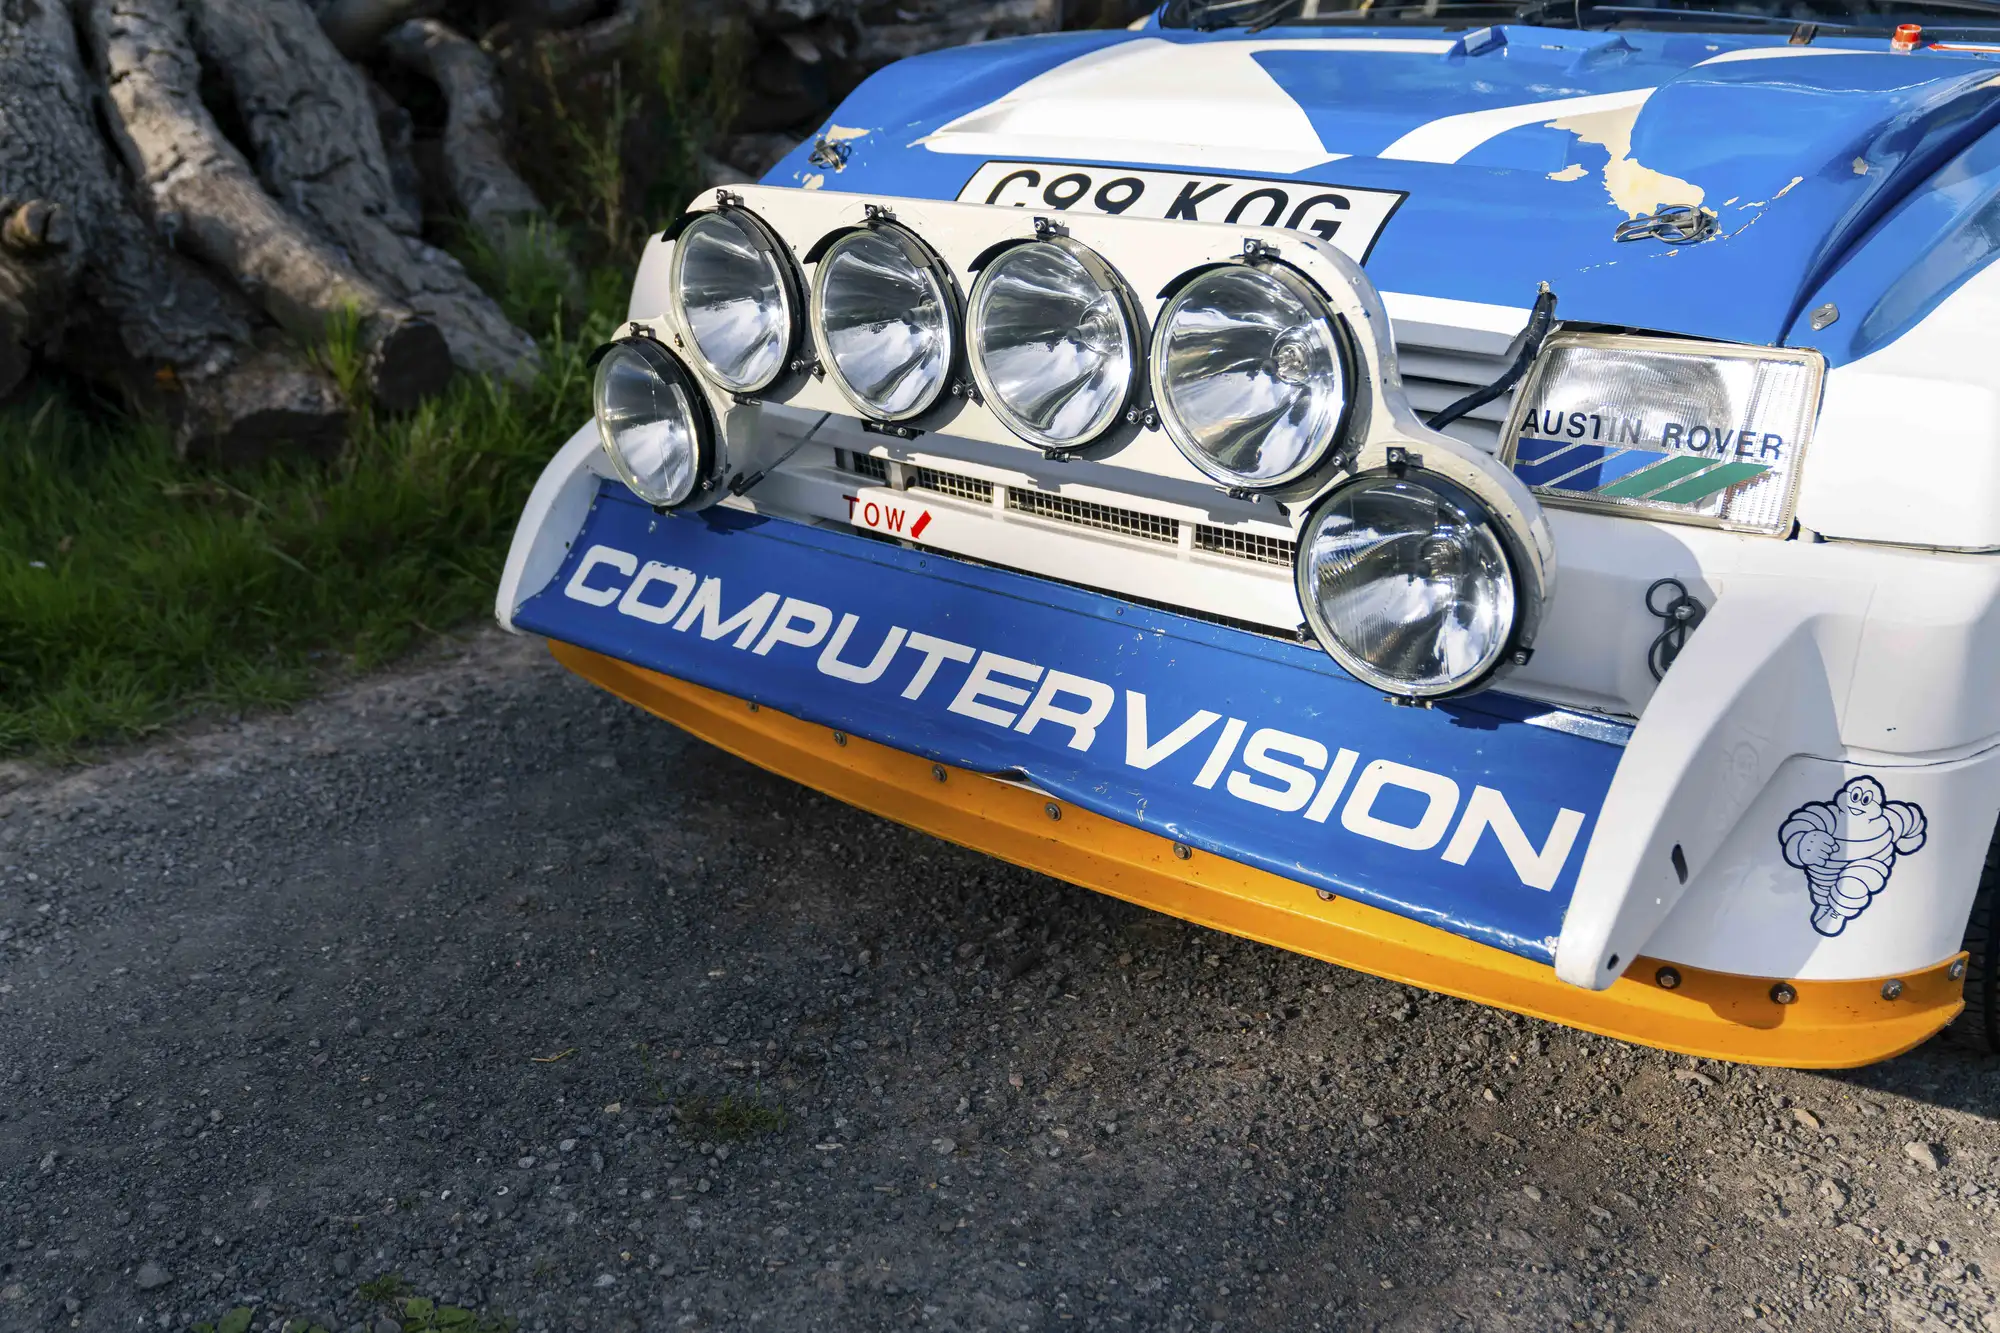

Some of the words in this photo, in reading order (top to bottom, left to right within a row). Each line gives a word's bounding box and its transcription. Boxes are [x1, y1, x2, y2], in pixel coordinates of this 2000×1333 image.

[985, 169, 1145, 215] C99
[1164, 181, 1351, 242] KOG
[1520, 407, 1643, 445] AUSTIN
[1660, 422, 1784, 460] ROVER
[842, 494, 906, 532] TOW
[563, 543, 1586, 893] COMPUTERVISION
